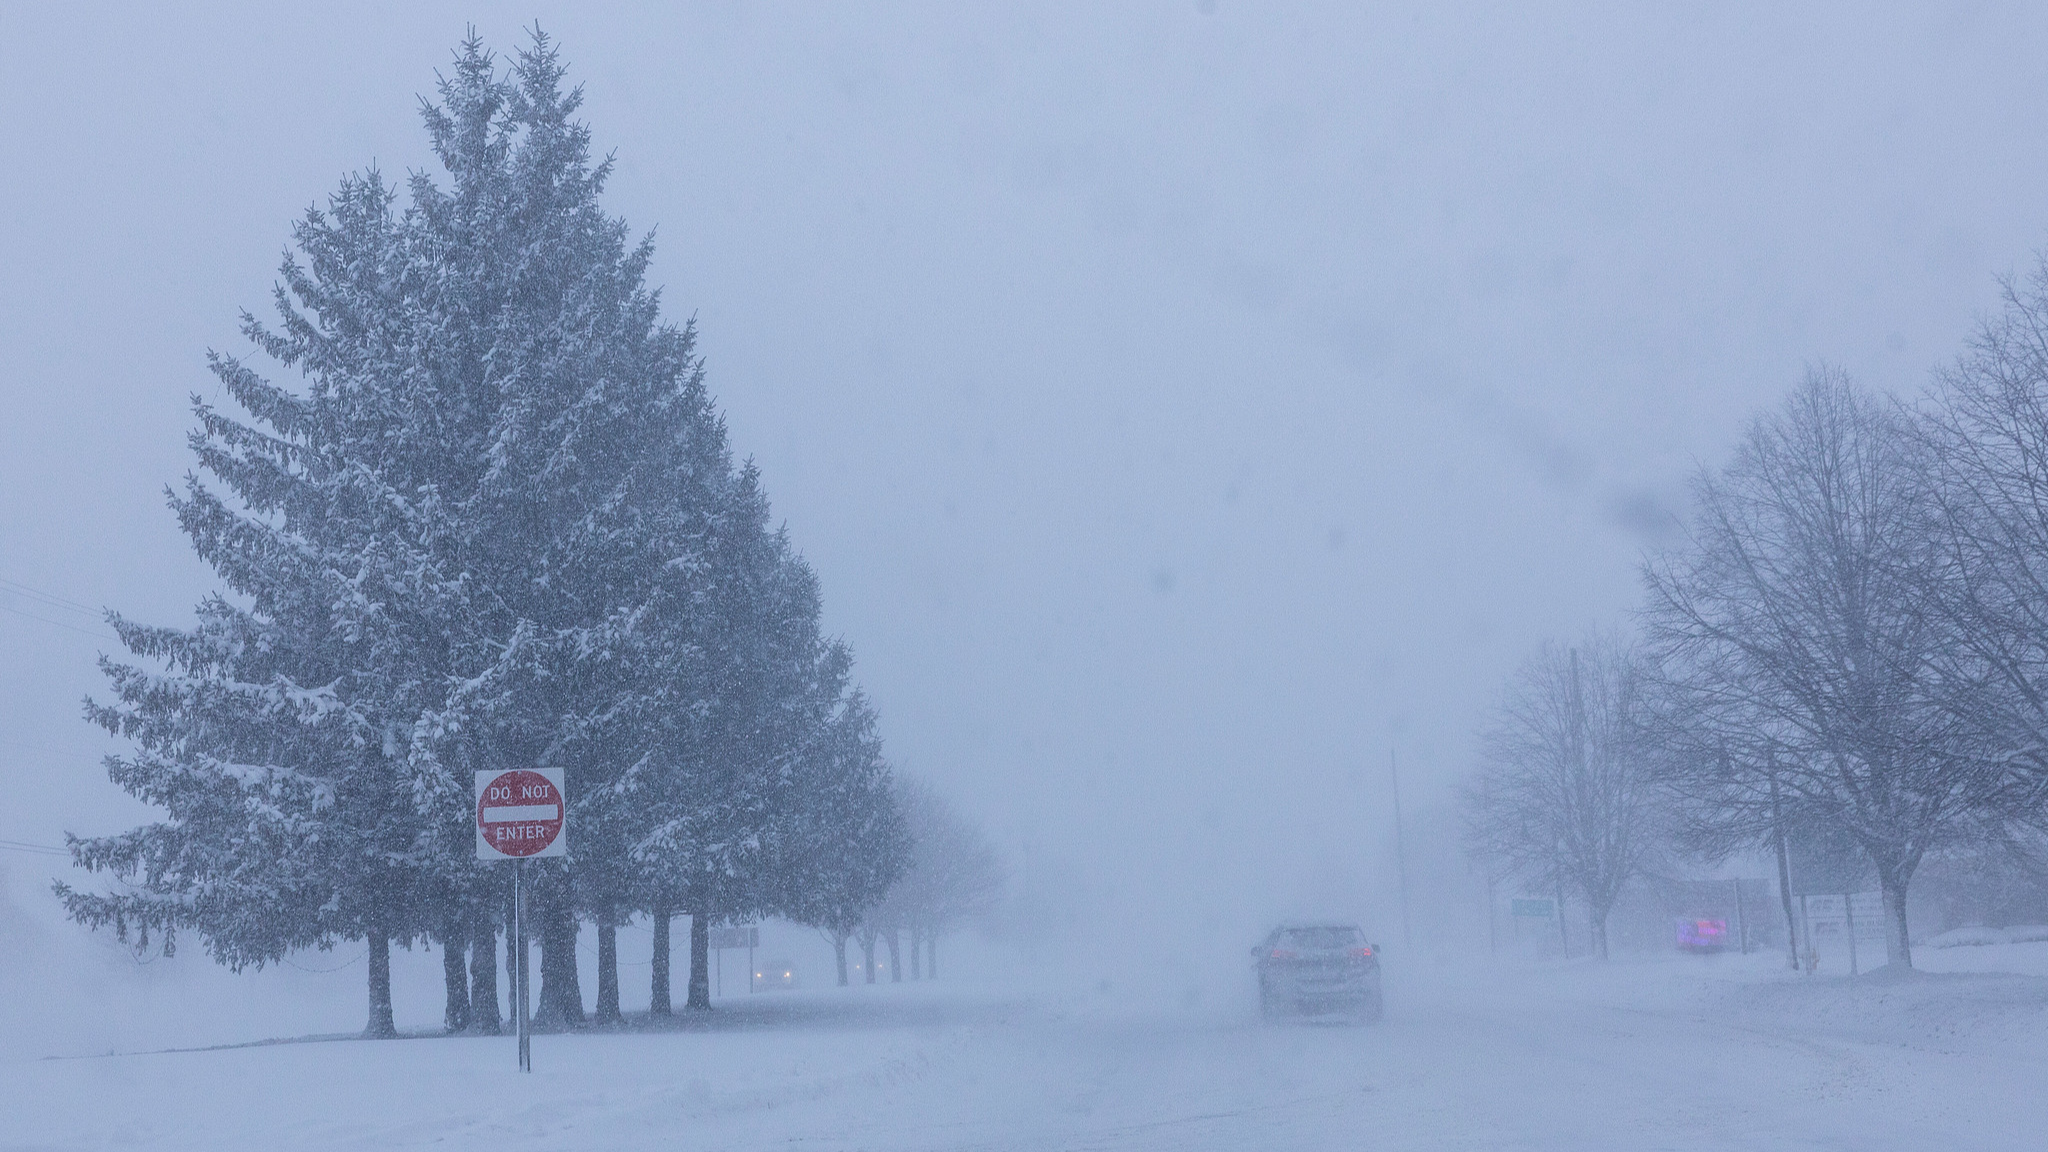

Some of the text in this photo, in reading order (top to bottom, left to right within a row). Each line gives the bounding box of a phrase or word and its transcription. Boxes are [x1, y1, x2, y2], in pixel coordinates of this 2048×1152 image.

[491, 785, 550, 800] DO NOT
[497, 825, 545, 840] ENTER
